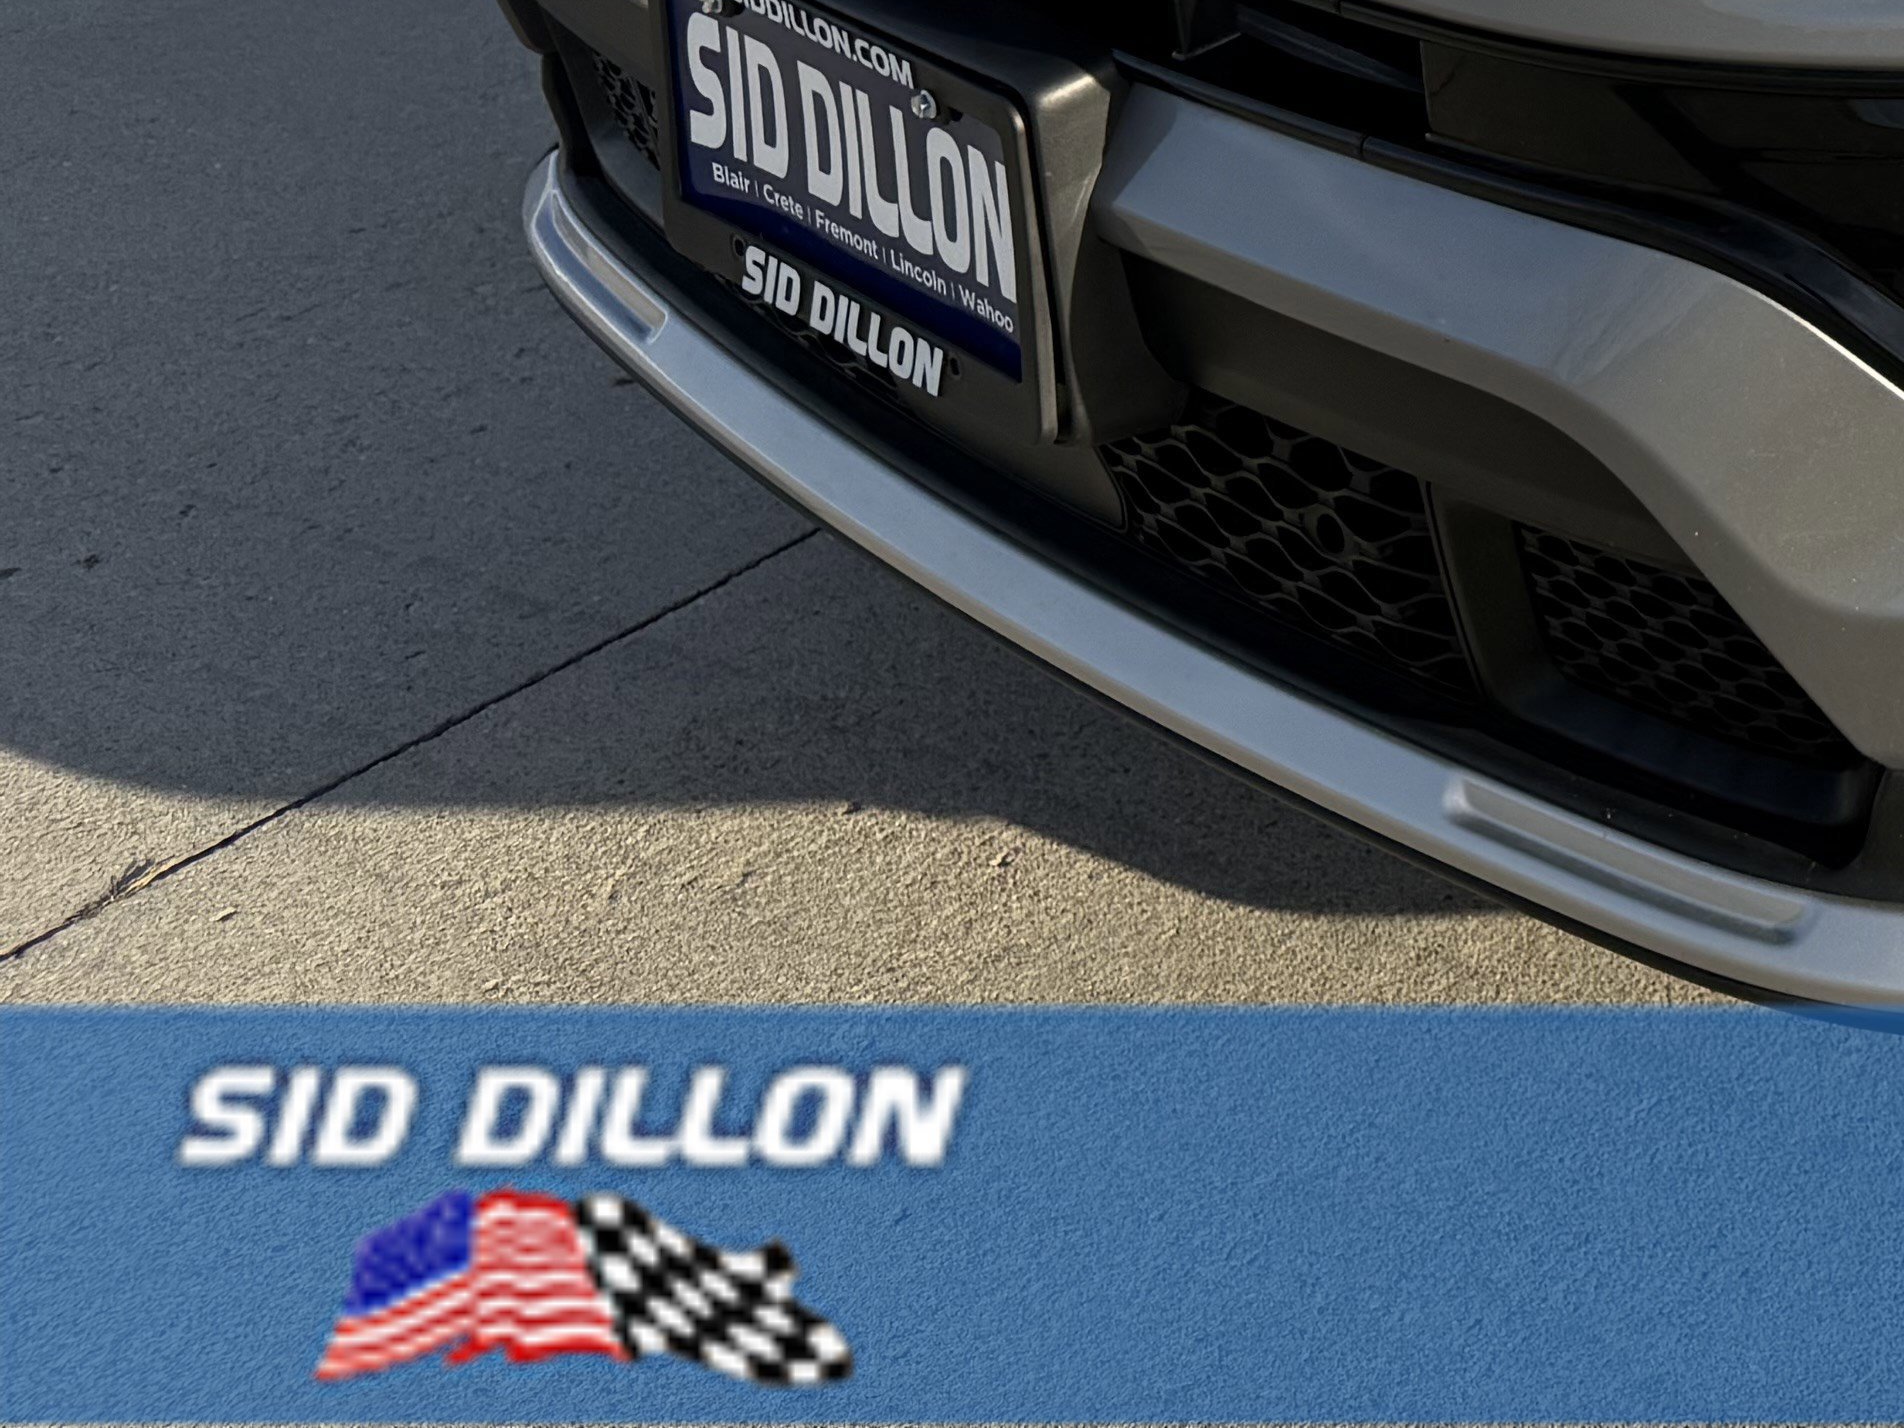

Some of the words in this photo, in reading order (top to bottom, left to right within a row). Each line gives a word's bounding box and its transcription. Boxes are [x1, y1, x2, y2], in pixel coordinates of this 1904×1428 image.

[686, 11, 789, 180] SID
[798, 60, 1018, 304] DILLON
[712, 162, 751, 196] Blair
[763, 182, 804, 221] Crete
[815, 209, 880, 262] Fremont
[890, 247, 947, 297] Lincoln
[958, 282, 1014, 334] Wahoo
[741, 245, 801, 318] SID
[809, 280, 945, 398] DILLON
